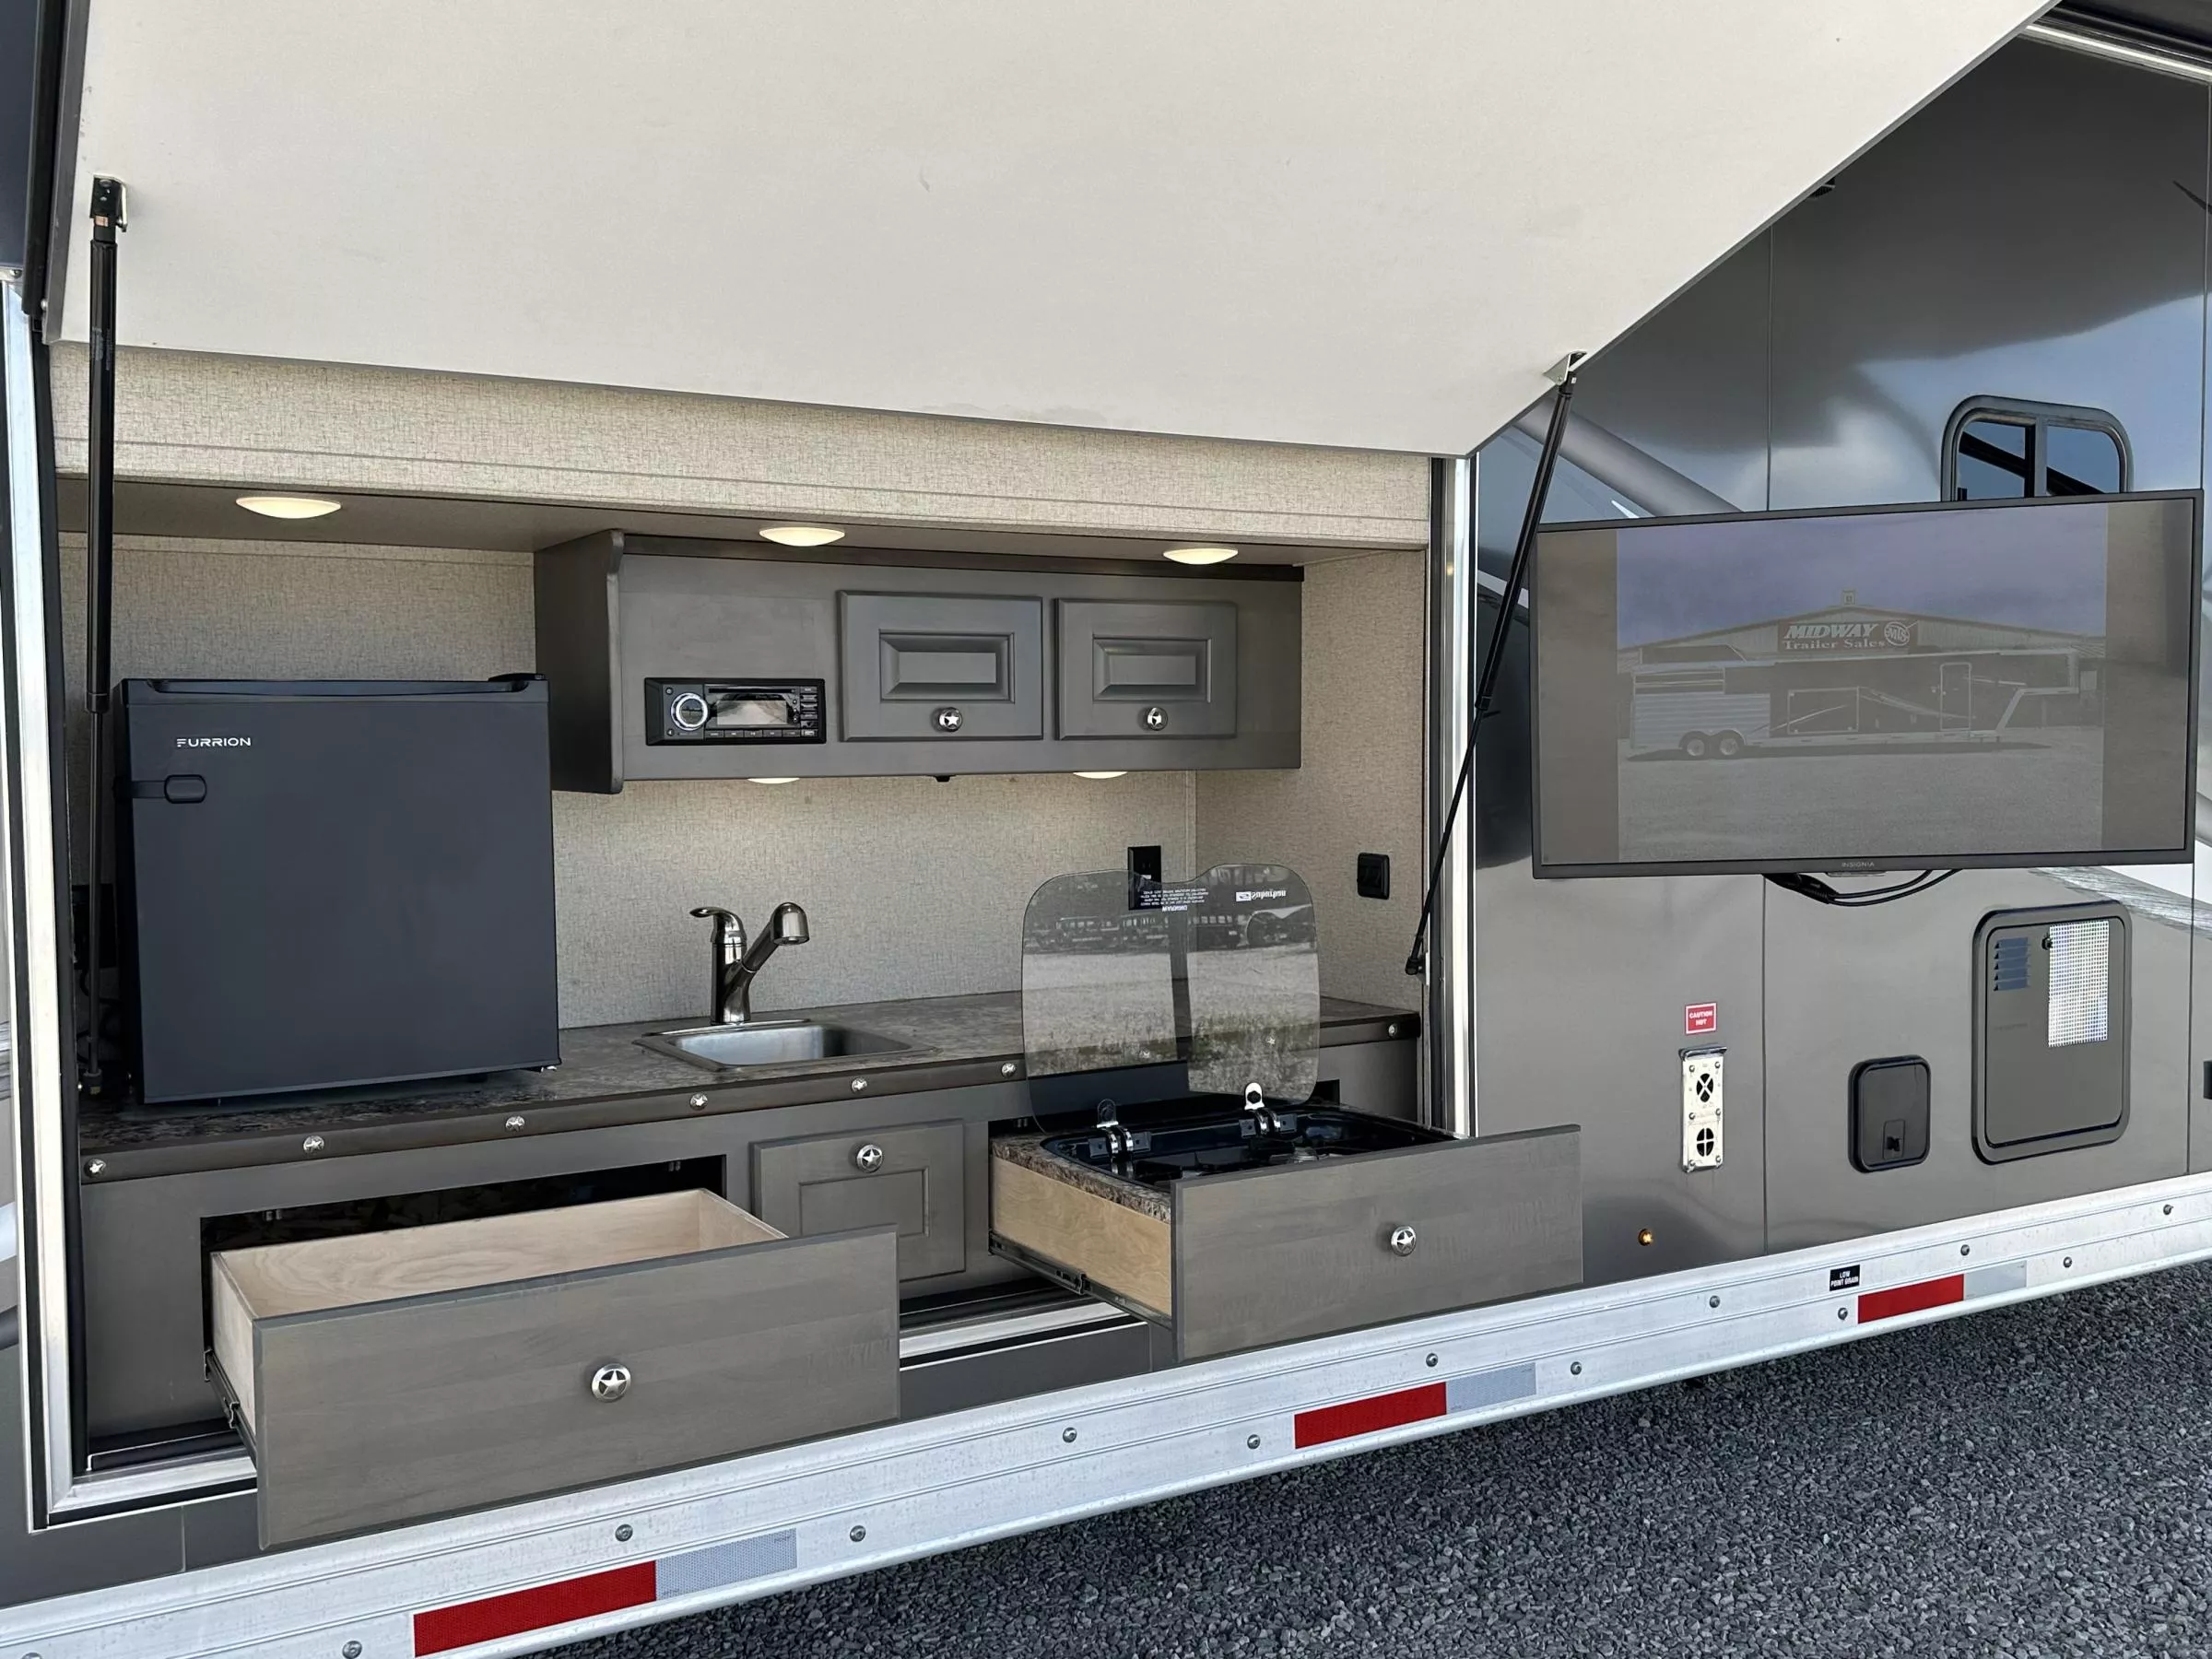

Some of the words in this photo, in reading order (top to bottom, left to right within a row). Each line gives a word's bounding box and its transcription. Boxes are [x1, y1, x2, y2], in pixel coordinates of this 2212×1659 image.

[1784, 623, 1879, 639] MIDWAY
[1783, 640, 1837, 650] Trailer
[1843, 638, 1886, 649] Sales
[177, 737, 252, 747] FURRION
[1688, 1010, 1713, 1018] CAUTION
[1696, 1018, 1707, 1026] HOT
[1839, 1270, 1850, 1278] LOW
